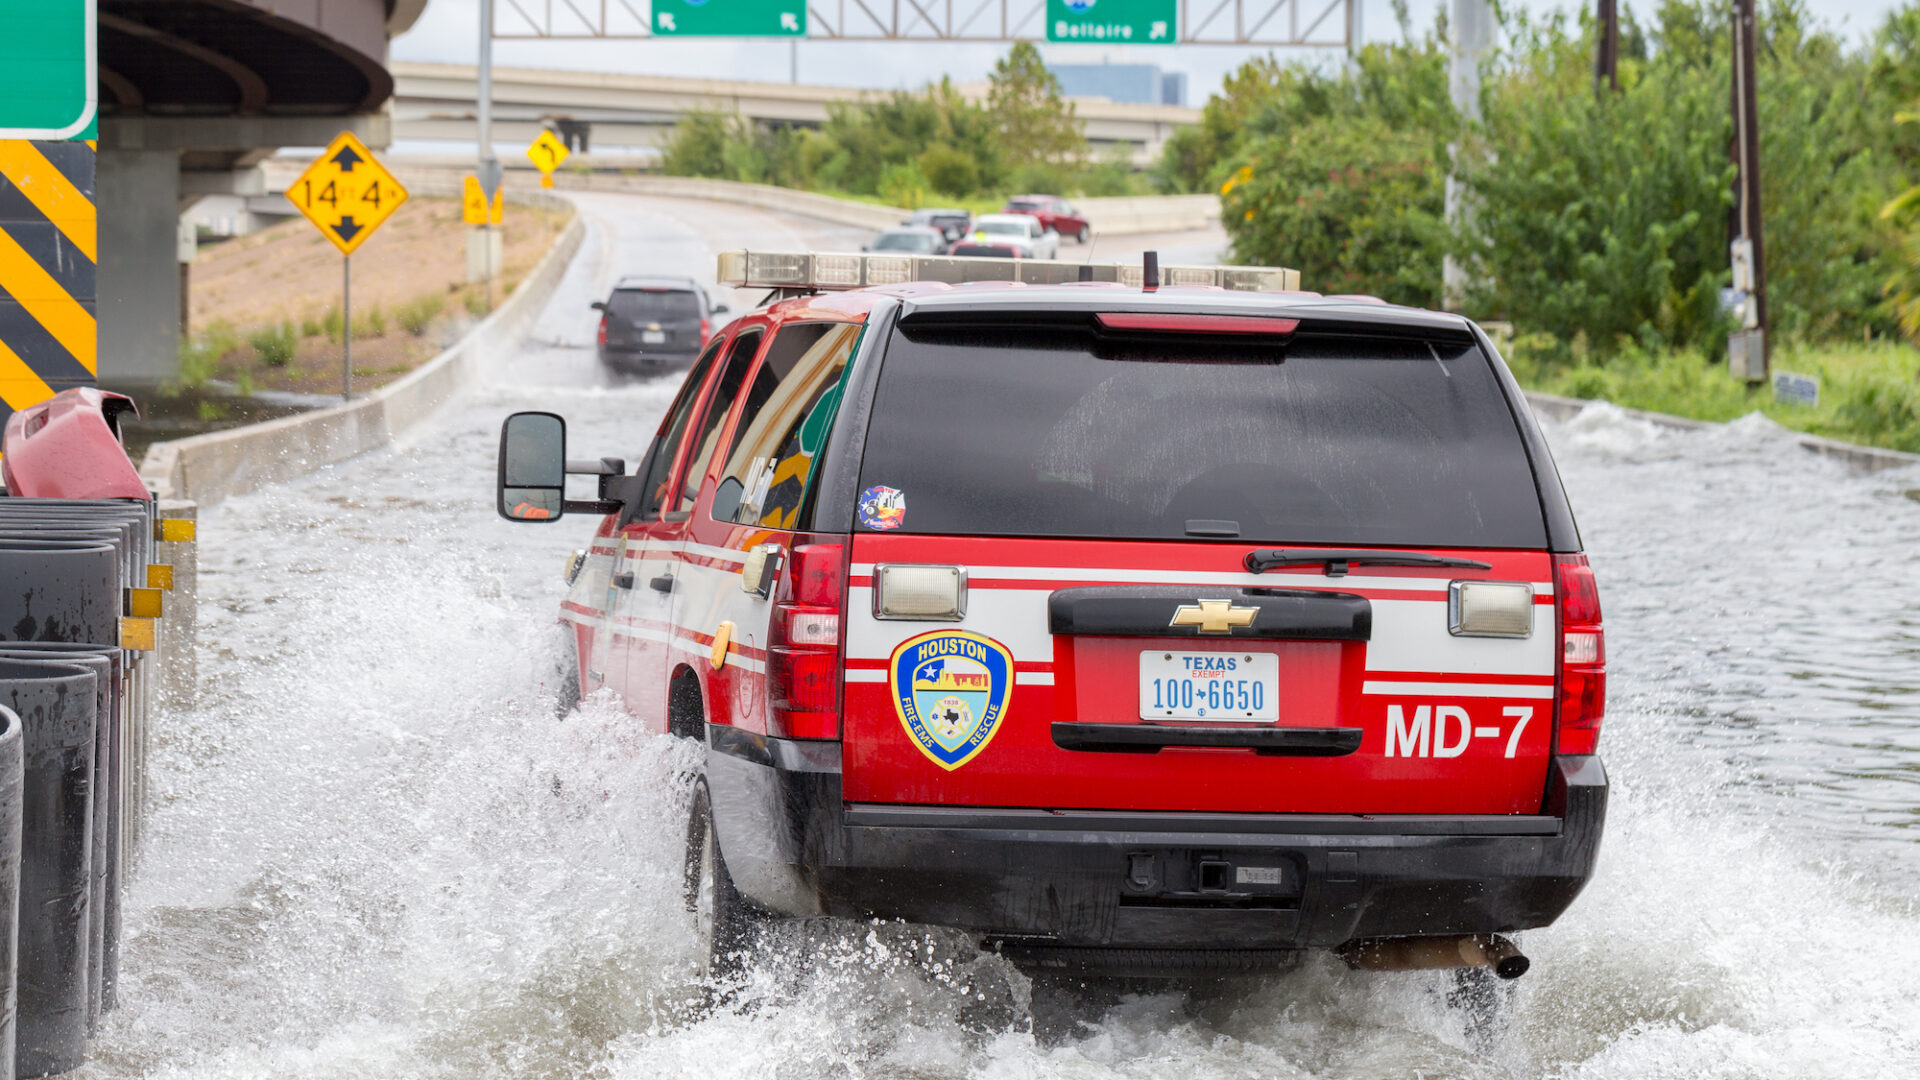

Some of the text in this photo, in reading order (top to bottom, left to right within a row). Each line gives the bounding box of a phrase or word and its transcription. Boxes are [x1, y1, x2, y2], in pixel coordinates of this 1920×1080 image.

[1055, 20, 1132, 39] Bellaire
[305, 180, 337, 209] 14
[361, 180, 380, 209] 4
[918, 638, 987, 663] HOUSTON
[1182, 656, 1237, 671] TEXAS
[1191, 669, 1226, 679] EXEMPT
[1153, 678, 1264, 711] 100 6650
[902, 696, 935, 748] FIRE-EMS
[969, 703, 1000, 747] RESCUE
[1384, 704, 1534, 759] MD-7
